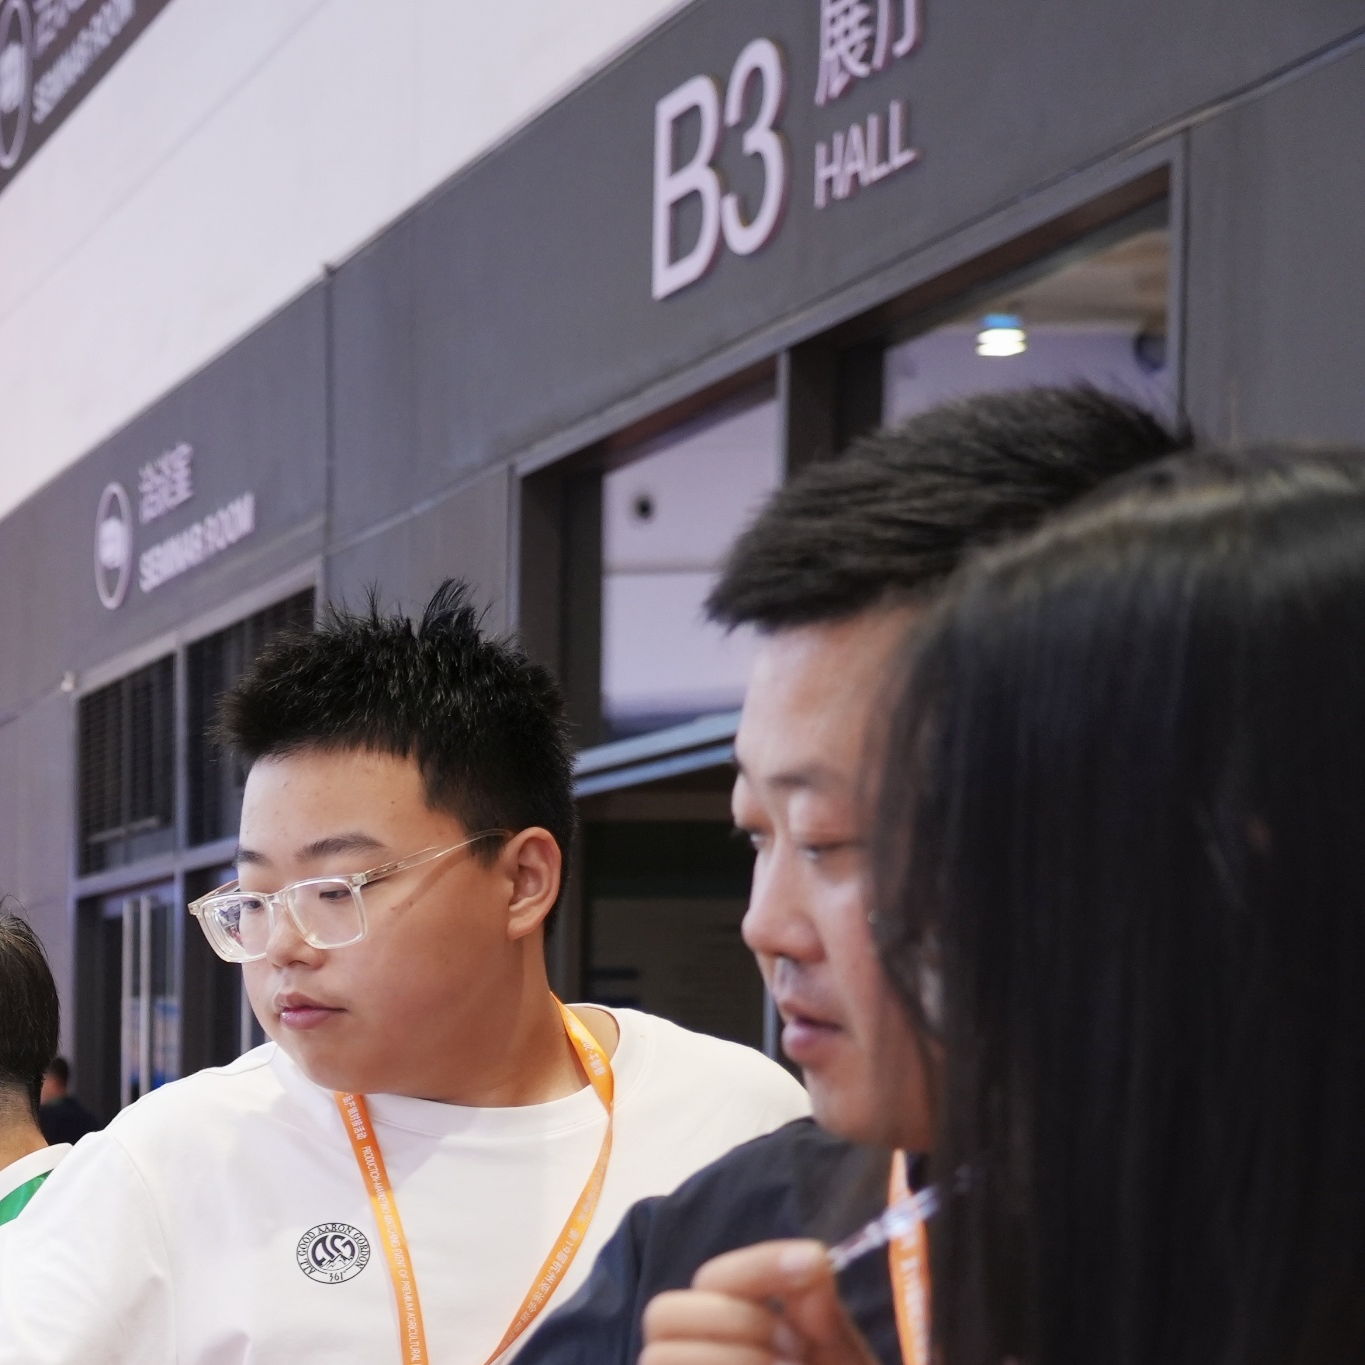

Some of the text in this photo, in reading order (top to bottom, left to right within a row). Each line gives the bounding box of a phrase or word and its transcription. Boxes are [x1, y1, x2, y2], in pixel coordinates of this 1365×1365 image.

[652, 37, 792, 300] B3
[814, 100, 921, 209] HALL
[297, 1223, 369, 1274] ALL GOOD AARON GORDON
[406, 1312, 421, 1363] AGRICULTURAL
